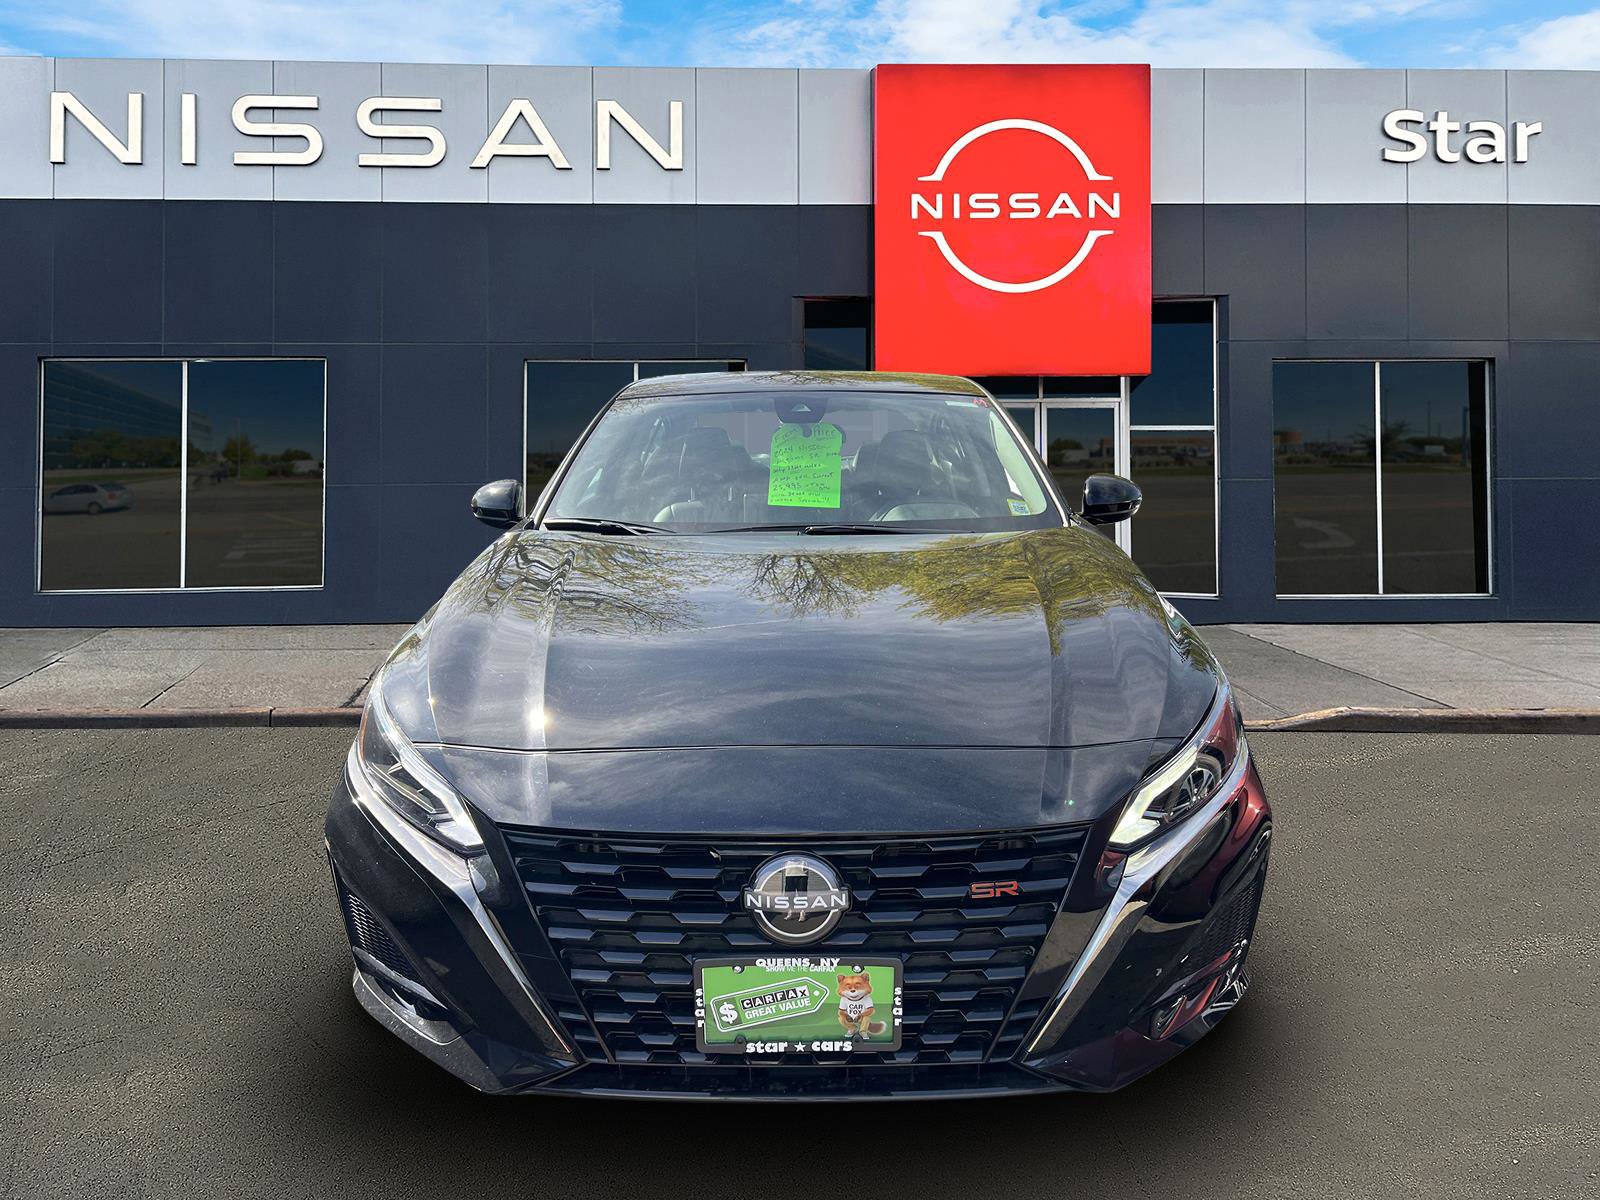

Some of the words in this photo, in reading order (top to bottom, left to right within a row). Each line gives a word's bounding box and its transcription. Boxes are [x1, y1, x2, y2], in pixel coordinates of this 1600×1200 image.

[49, 91, 683, 171] NISSAN
[1381, 109, 1543, 165] Star
[911, 192, 1120, 220] NISSAN
[971, 881, 1019, 898] SR
[746, 893, 848, 909] NISSAN
[755, 957, 815, 969] QUEENS,
[820, 957, 840, 968] NY
[742, 987, 808, 1009] CARFAX
[744, 1004, 777, 1019] GREAT
[778, 998, 811, 1012] VALUE
[745, 1041, 788, 1053] star
[811, 1040, 853, 1052] cars
